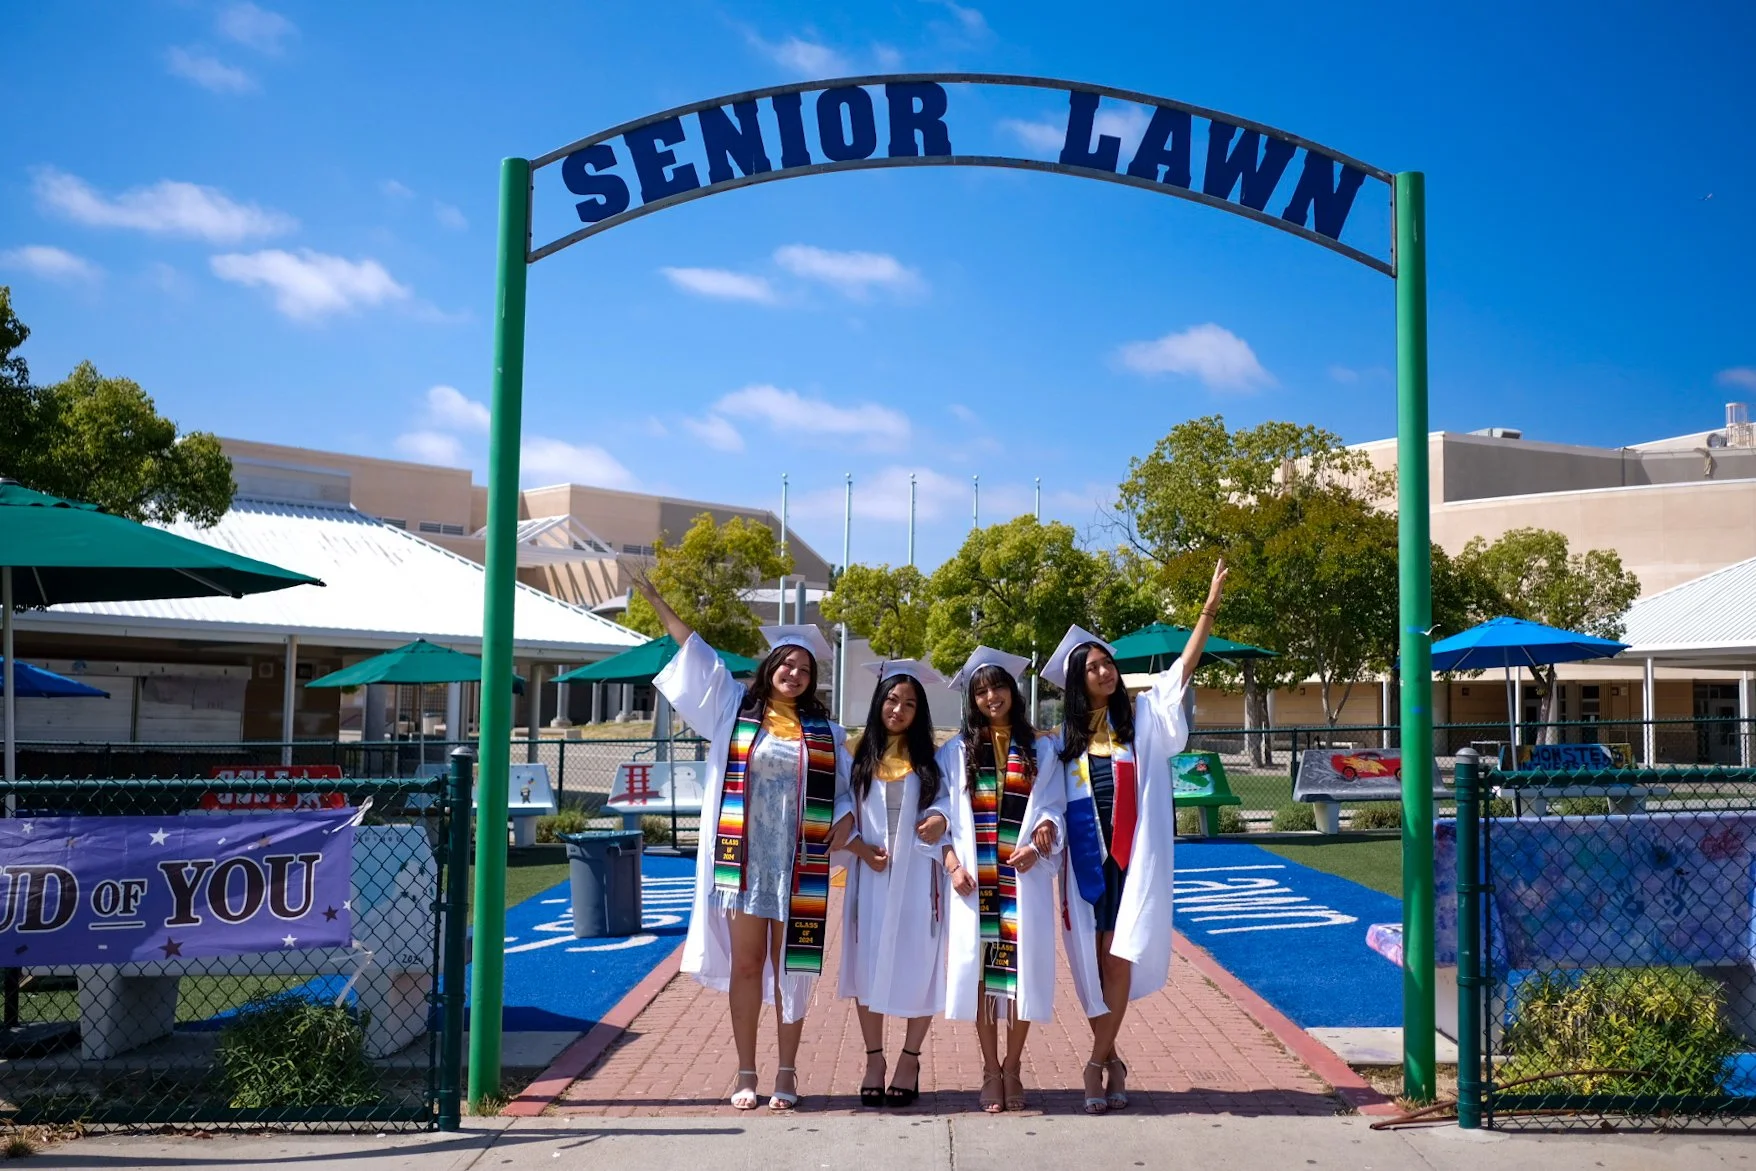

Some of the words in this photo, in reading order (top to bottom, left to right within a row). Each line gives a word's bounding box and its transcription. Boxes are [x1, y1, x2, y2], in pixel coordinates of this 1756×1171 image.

[561, 81, 952, 223] SENIOR
[1059, 89, 1367, 241] LAWN
[721, 838, 739, 846] CLASS
[722, 853, 735, 861] 2024
[90, 878, 148, 917] OF
[157, 852, 322, 928] YOU
[980, 889, 993, 897] ASS
[794, 921, 819, 929] CLASS
